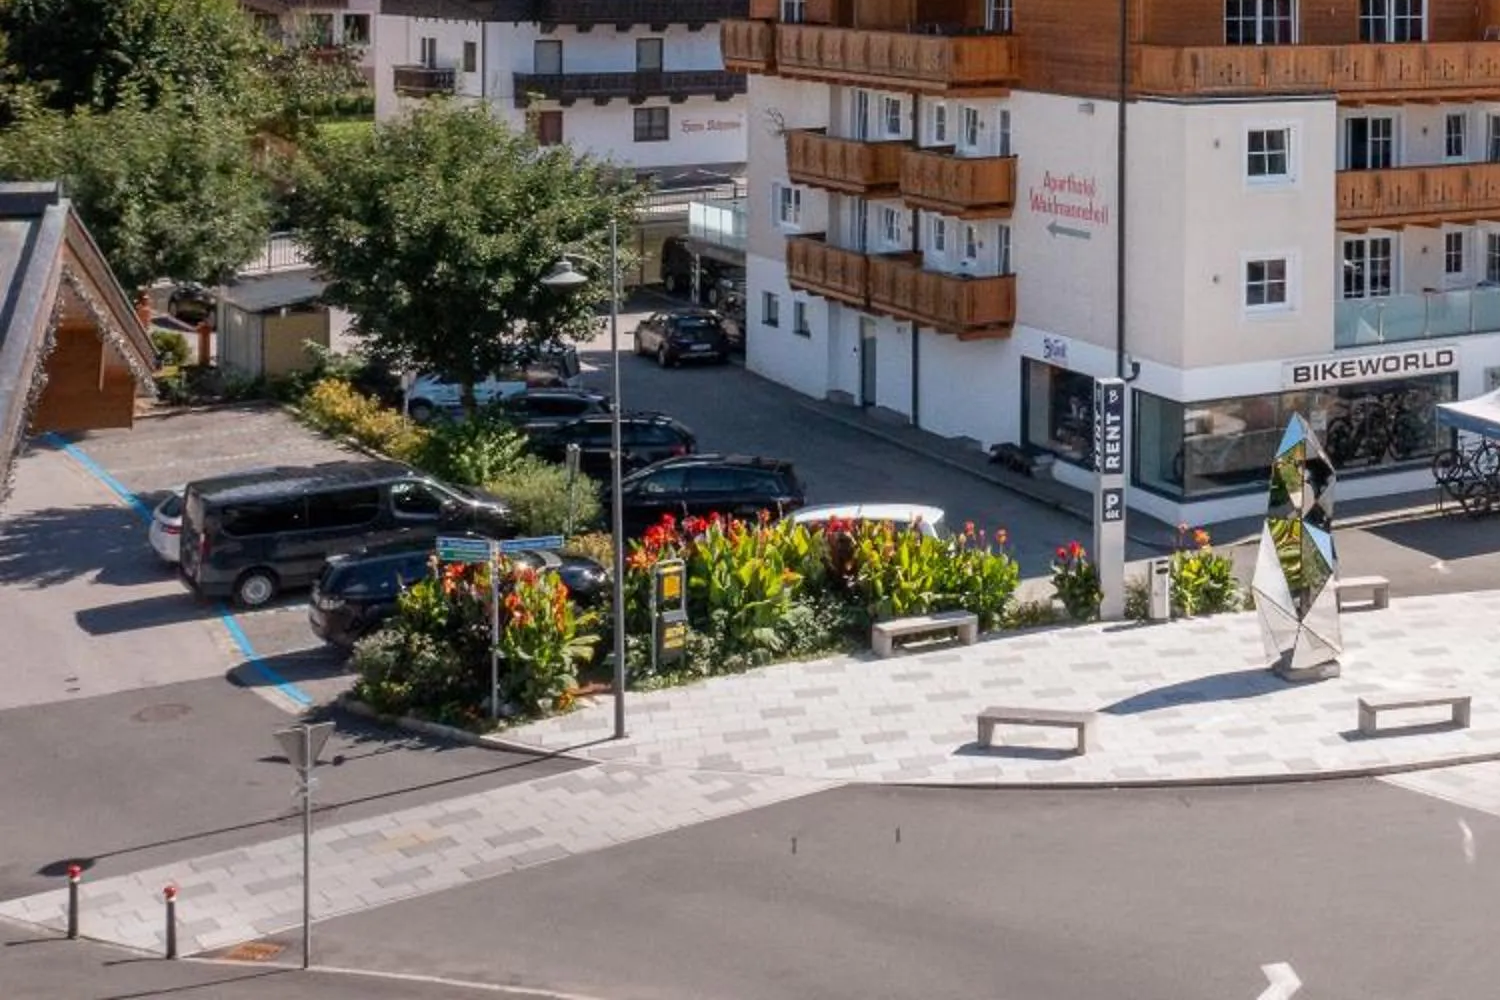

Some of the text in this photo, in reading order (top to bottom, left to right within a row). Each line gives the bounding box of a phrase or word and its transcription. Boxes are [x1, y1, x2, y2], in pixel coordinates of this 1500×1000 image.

[1293, 349, 1455, 384] BIKEWORLD
[1104, 411, 1121, 469] RENT
[1105, 493, 1119, 509] P
